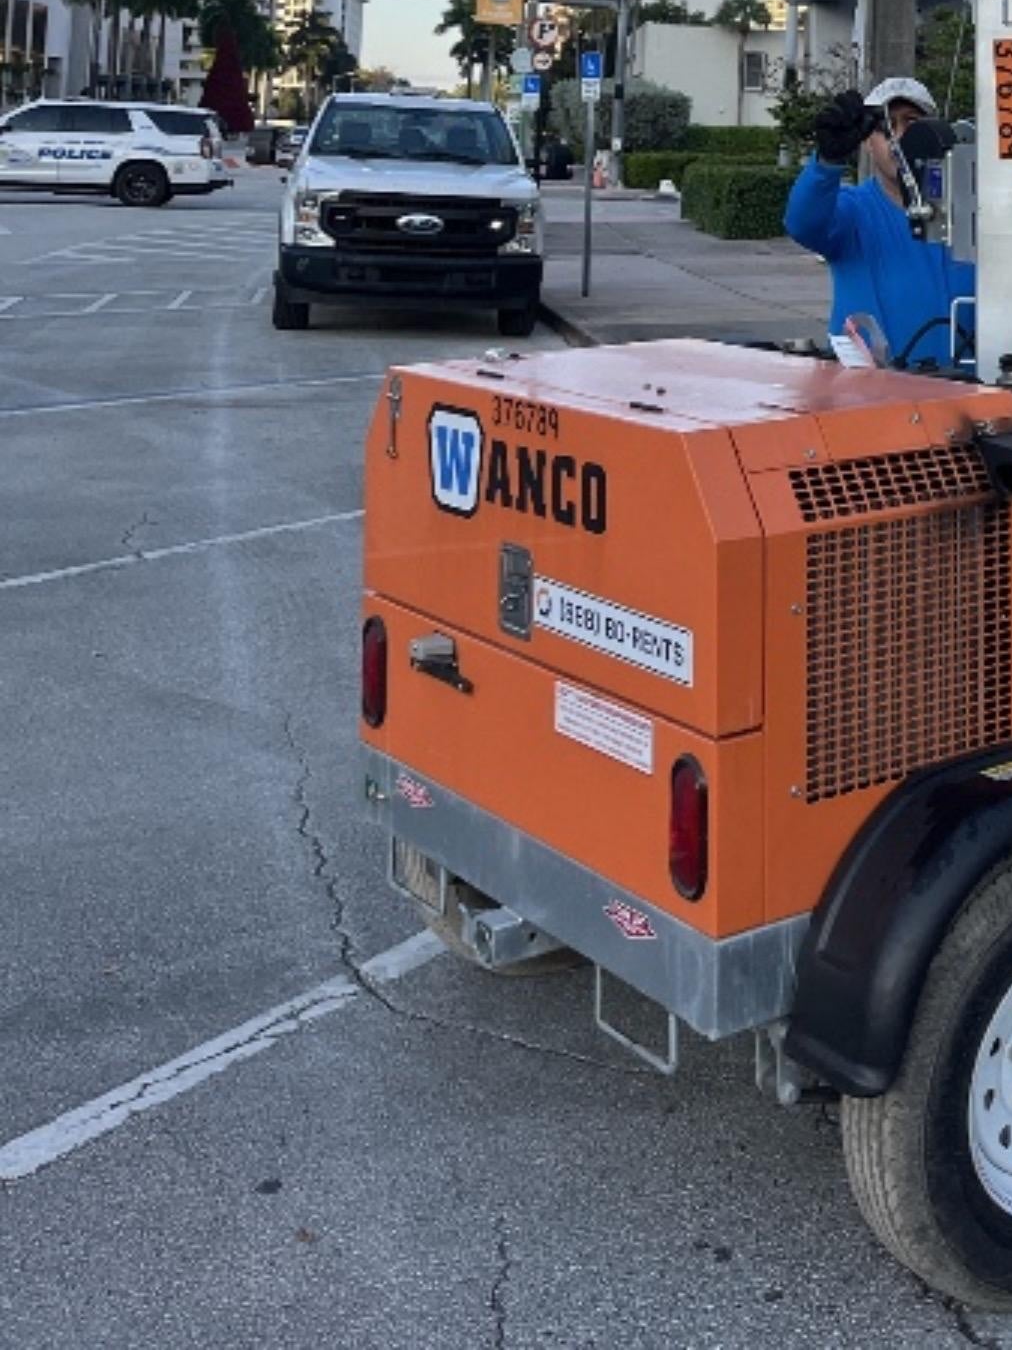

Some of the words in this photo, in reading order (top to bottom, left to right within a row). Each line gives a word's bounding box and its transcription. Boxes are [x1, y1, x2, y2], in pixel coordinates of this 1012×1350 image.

[38, 147, 112, 159] POLICE
[491, 394, 559, 440] 376789
[430, 418, 608, 535] WANCO
